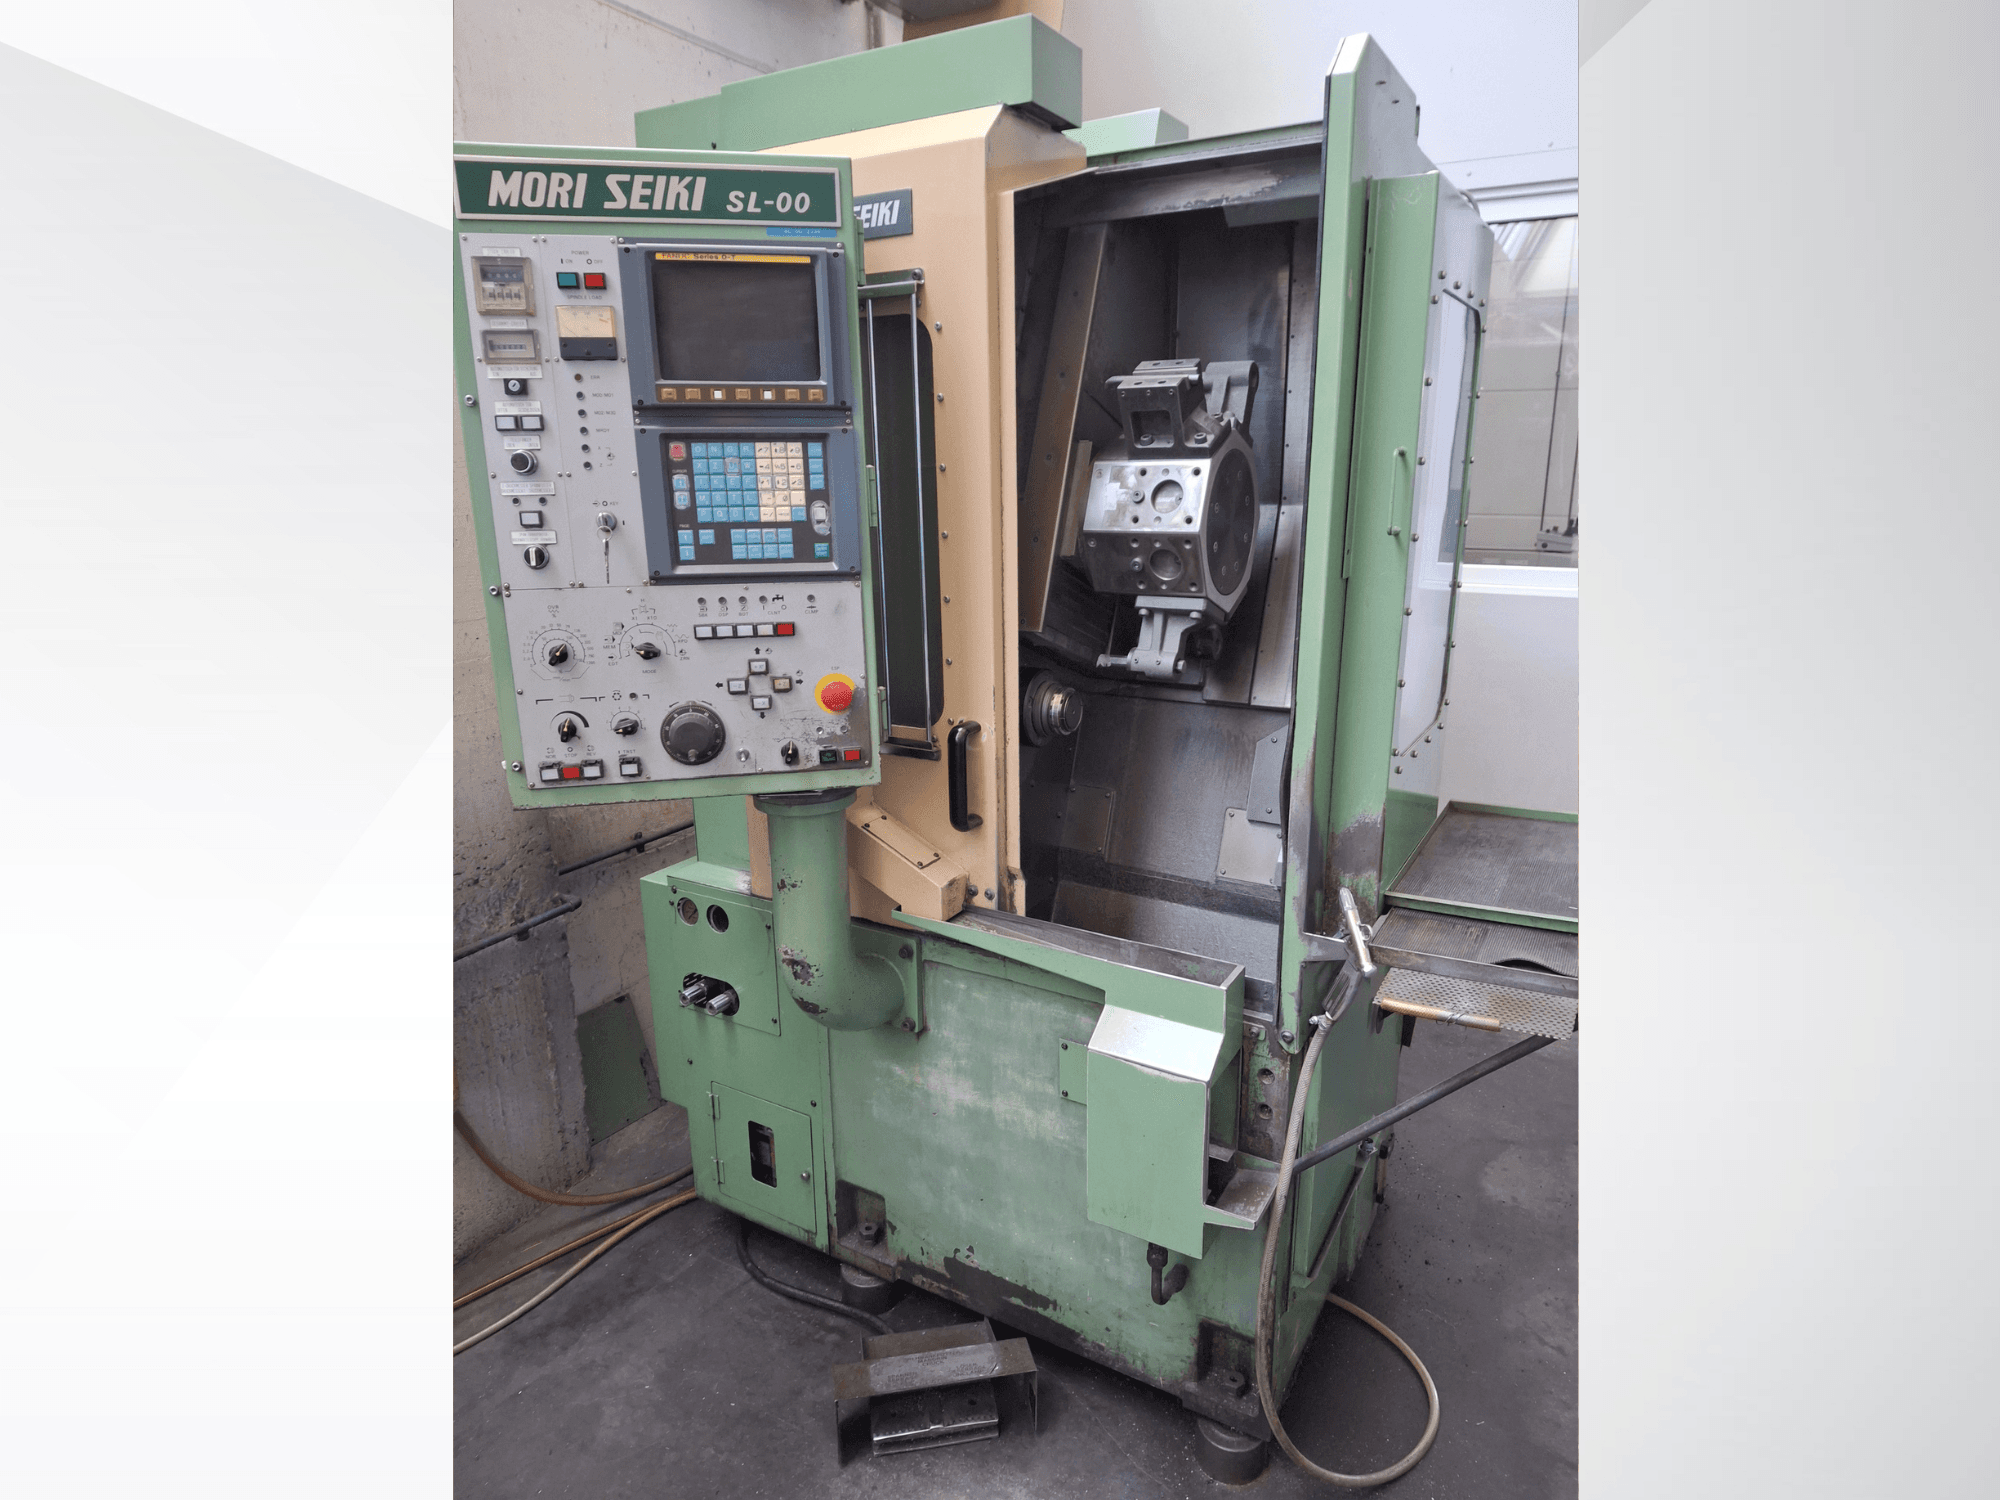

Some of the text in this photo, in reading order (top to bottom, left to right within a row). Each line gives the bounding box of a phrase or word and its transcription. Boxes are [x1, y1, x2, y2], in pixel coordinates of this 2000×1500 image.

[487, 170, 811, 214] MORI SEIKI SL-00
